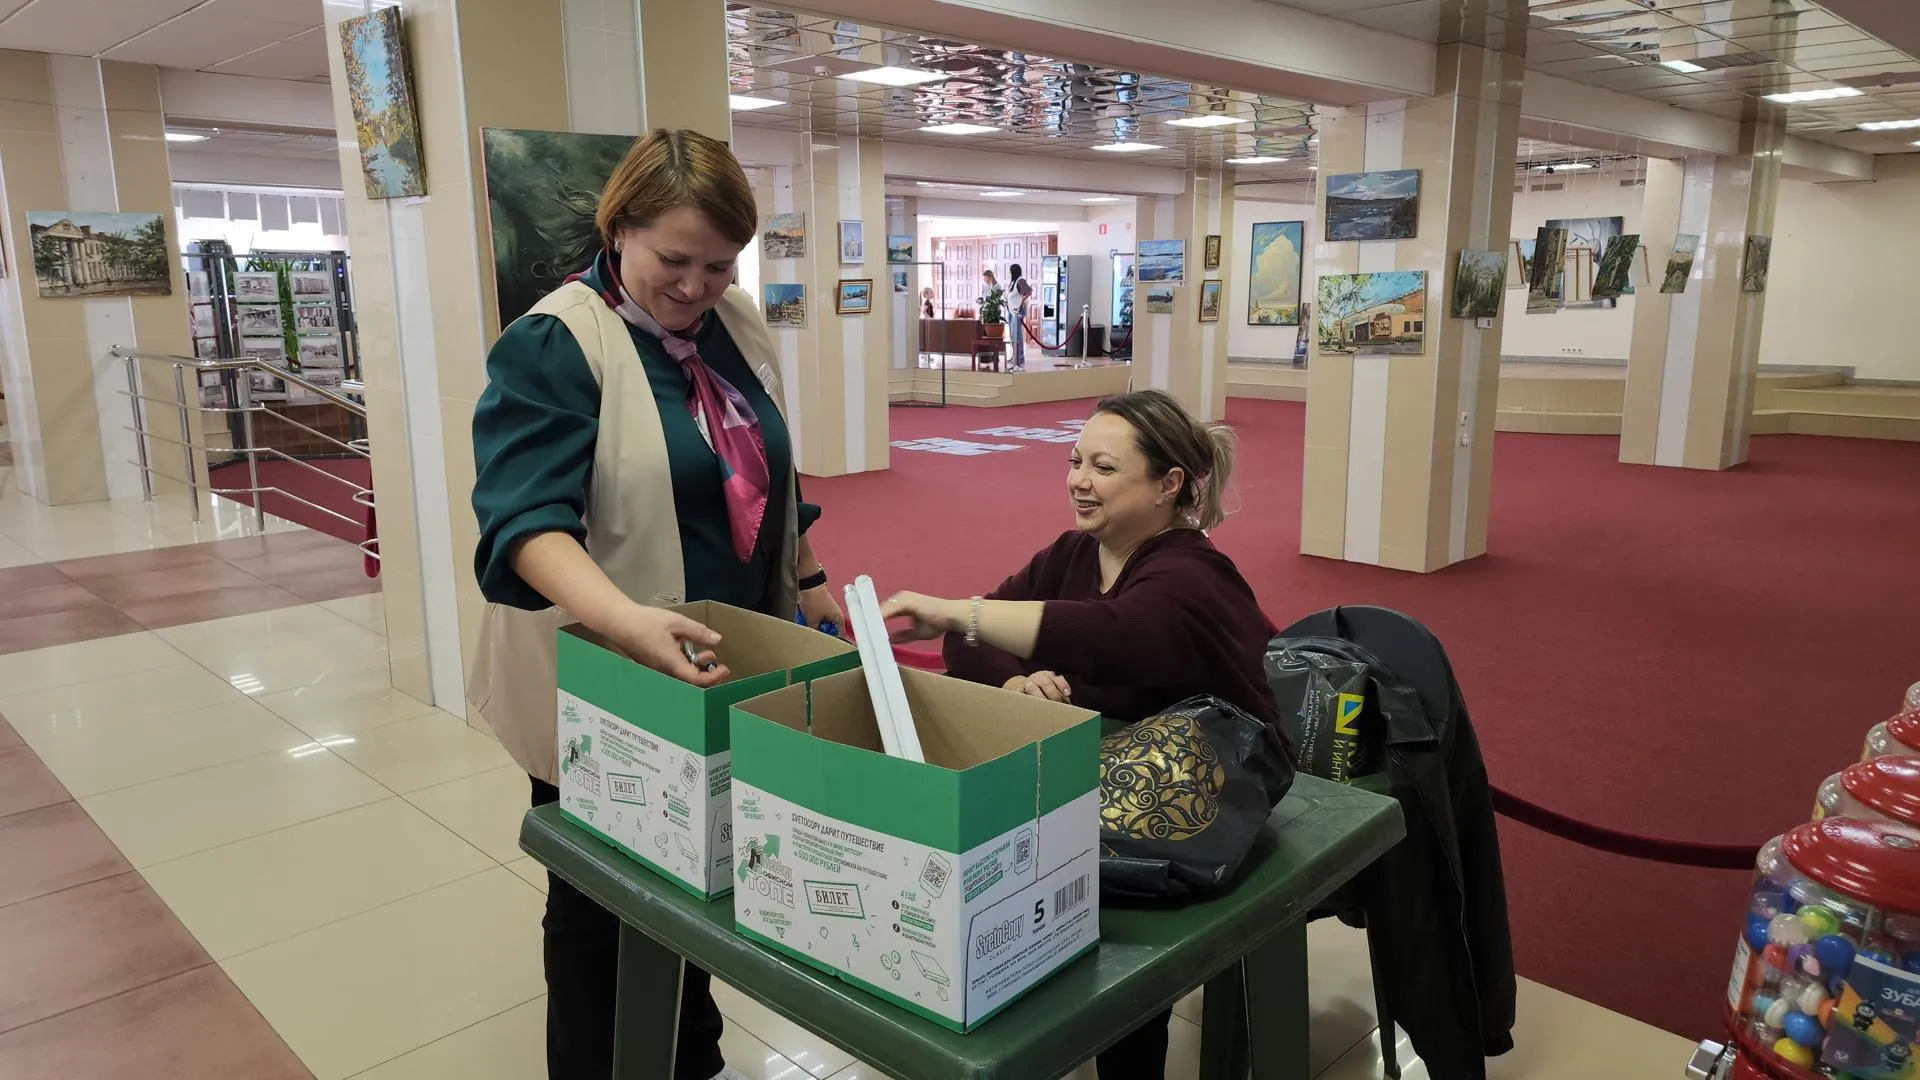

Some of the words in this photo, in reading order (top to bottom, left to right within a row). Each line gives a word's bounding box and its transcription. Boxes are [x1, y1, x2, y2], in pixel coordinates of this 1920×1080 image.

[614, 780, 636, 795] БИЛЕТ
[791, 813, 821, 832] SVETOCOPY
[820, 825, 841, 838] ДАРИТ
[840, 830, 885, 853] ПУТЕШЕСТВИЕ
[819, 859, 841, 874] РУБЛЕЙ
[748, 873, 795, 910] ТОПЕ
[815, 888, 850, 906] БИЛЕТ
[1034, 898, 1045, 924] 5
[976, 914, 1024, 959] SvetoCopy
[989, 944, 1012, 961] CLASSIC
